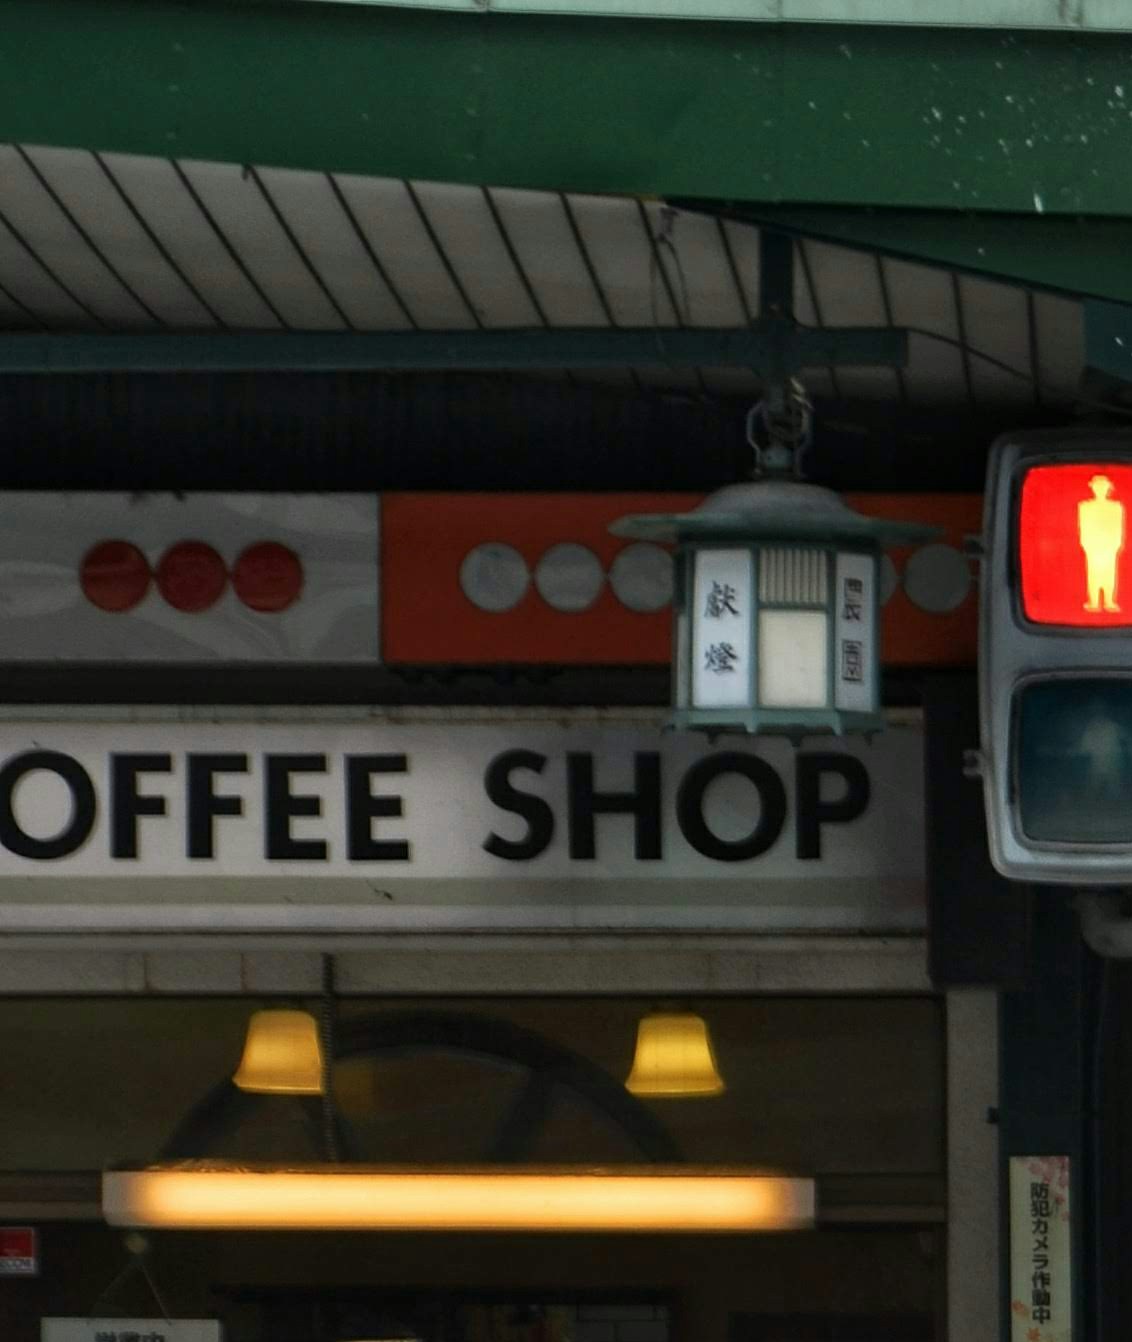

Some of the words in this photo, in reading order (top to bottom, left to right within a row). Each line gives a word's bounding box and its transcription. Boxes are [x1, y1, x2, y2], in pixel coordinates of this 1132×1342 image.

[482, 748, 871, 862] SHOP
[1030, 1182, 1051, 1325] 防犯カメラ作動中
